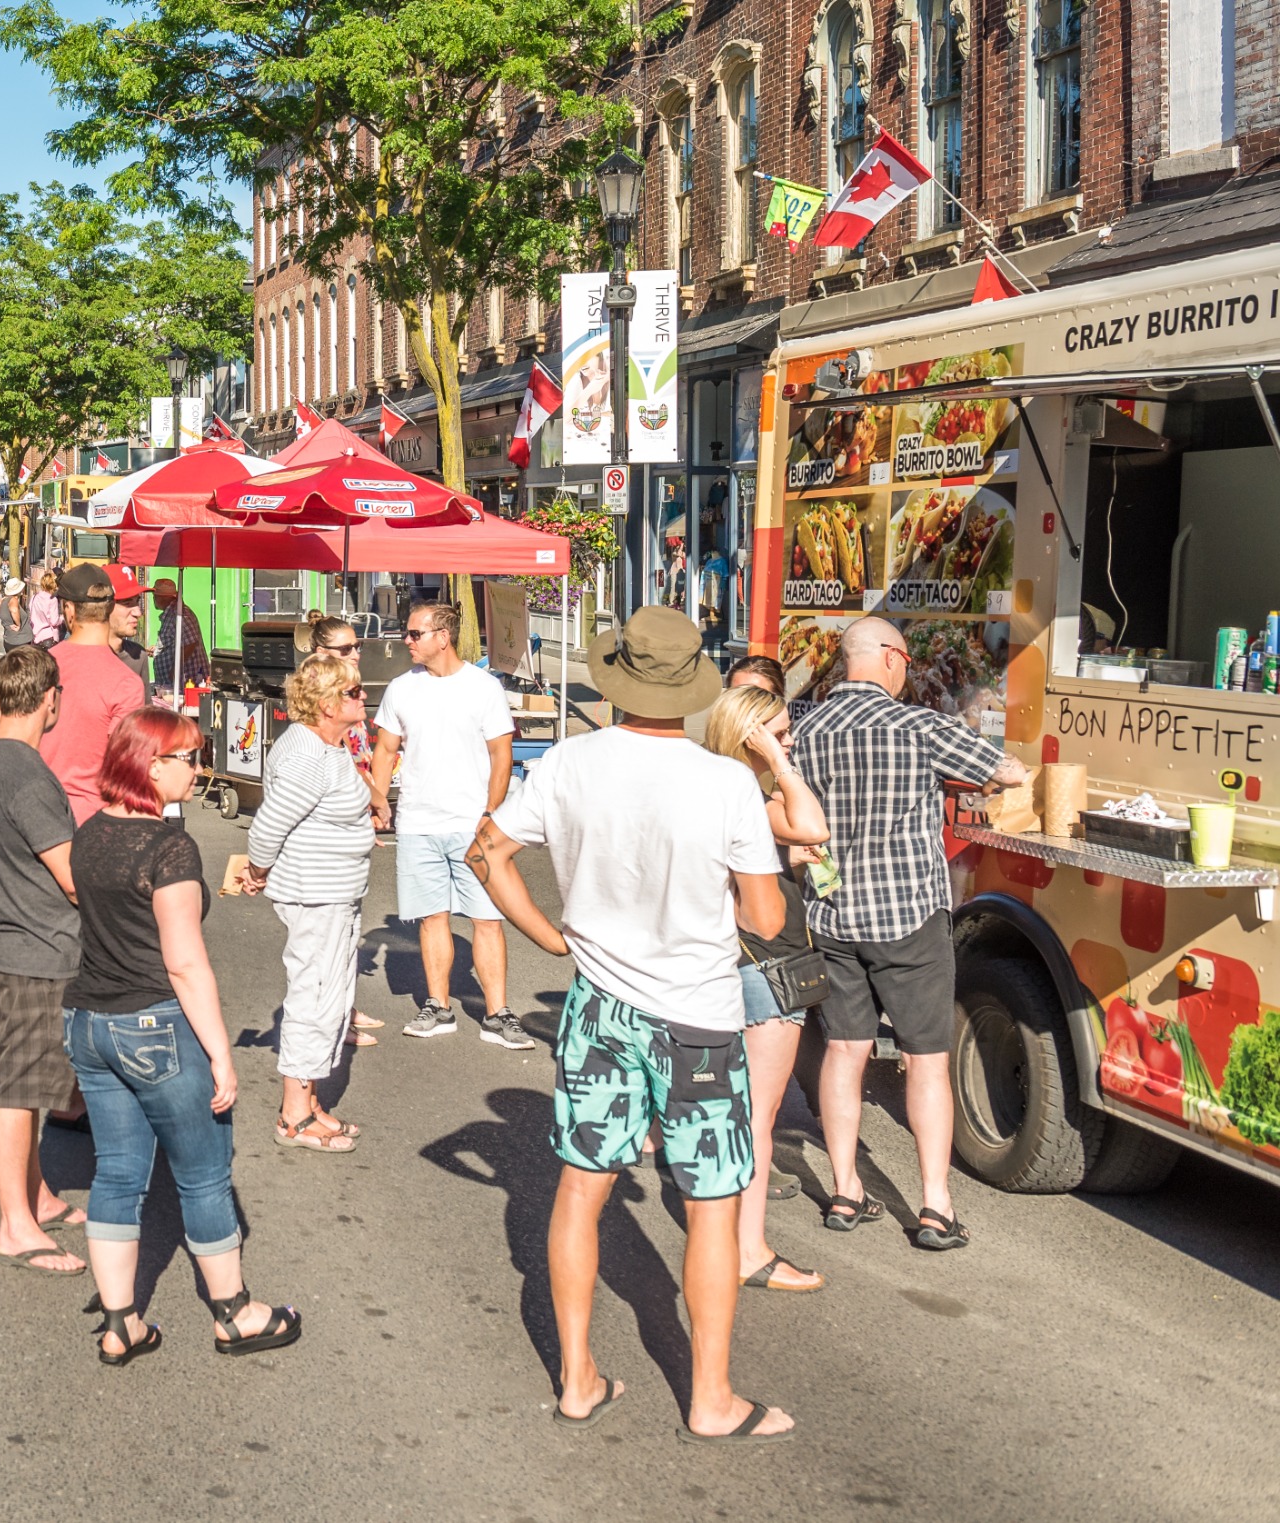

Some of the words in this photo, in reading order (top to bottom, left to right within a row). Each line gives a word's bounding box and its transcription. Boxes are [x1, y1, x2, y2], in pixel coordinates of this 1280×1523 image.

[588, 286, 602, 337] TASTE
[655, 283, 669, 343] THRIVE
[1065, 315, 1140, 353] CRAZY
[1147, 294, 1259, 340] BURRITO
[163, 404, 171, 432] THRIVE
[897, 437, 922, 451] CRAZY
[790, 460, 834, 484] BURRITO
[897, 449, 944, 472] BURRITO
[946, 445, 982, 468] BOWL
[371, 503, 408, 514] Lesters
[785, 585, 813, 603] HARD
[814, 584, 842, 604] TACO
[890, 585, 921, 603] SOFT
[925, 584, 960, 605] TACO
[1058, 697, 1107, 738] BON
[1119, 702, 1264, 762] APPETITE
